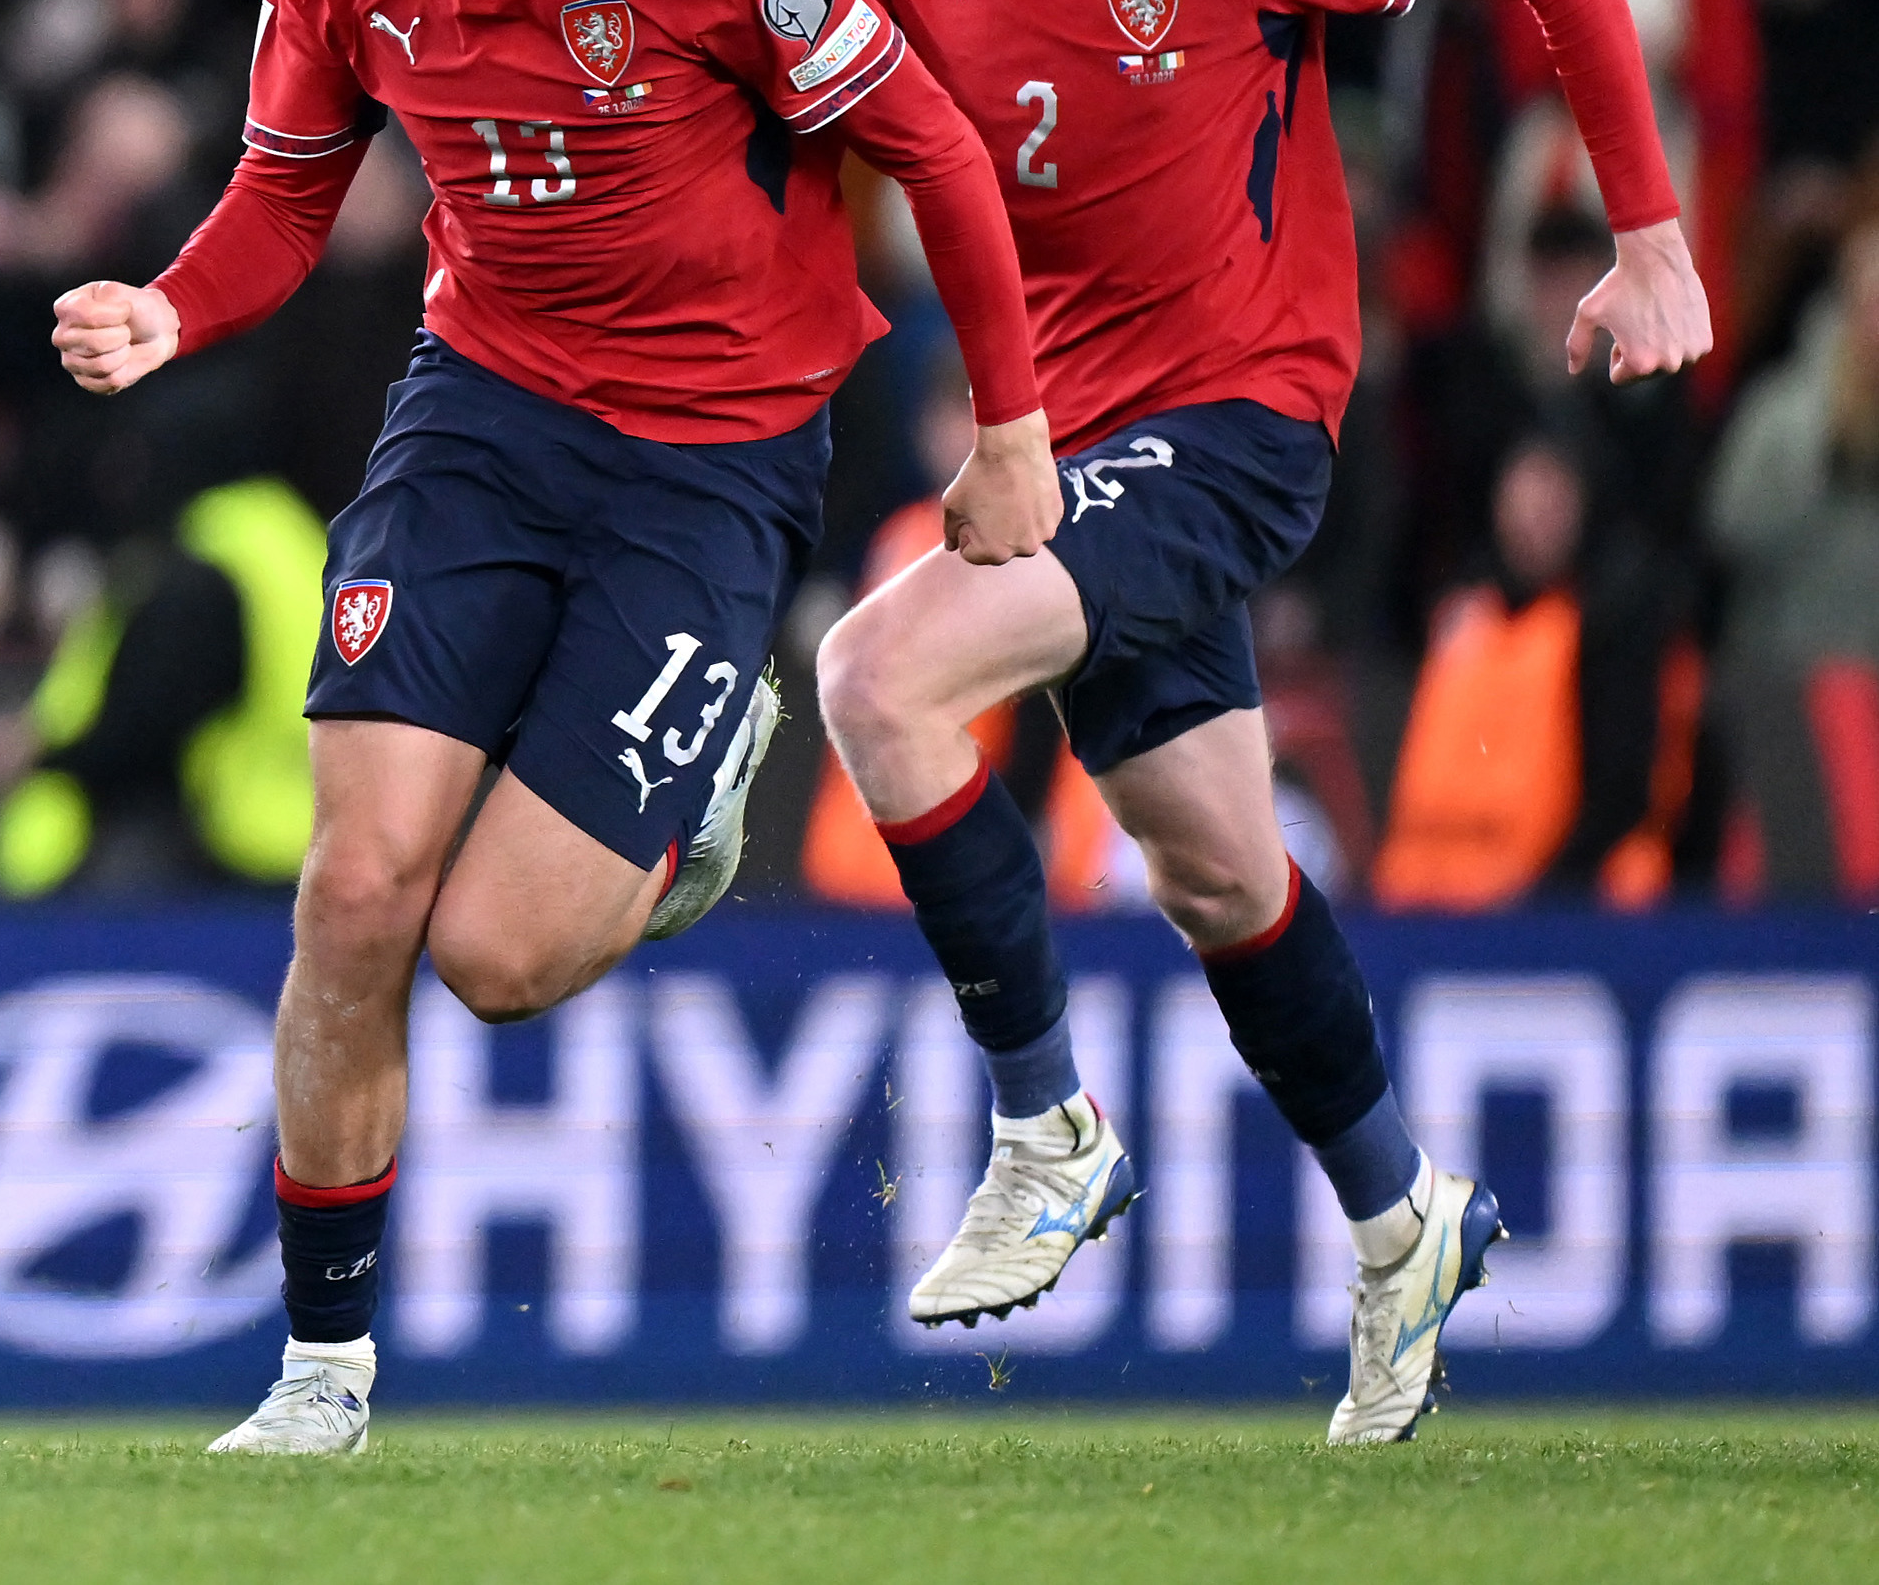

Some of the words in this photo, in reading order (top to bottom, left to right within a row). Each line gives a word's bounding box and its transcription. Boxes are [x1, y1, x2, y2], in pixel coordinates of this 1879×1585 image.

[796, 8, 873, 84] FOUNDATION
[471, 119, 577, 206] 13
[1016, 80, 1058, 187] 2
[1082, 436, 1175, 500] 2
[611, 632, 739, 766] 13
[951, 979, 1000, 996] ZE
[389, 972, 1878, 1357] HYUNDA
[325, 1248, 377, 1281] CZE
